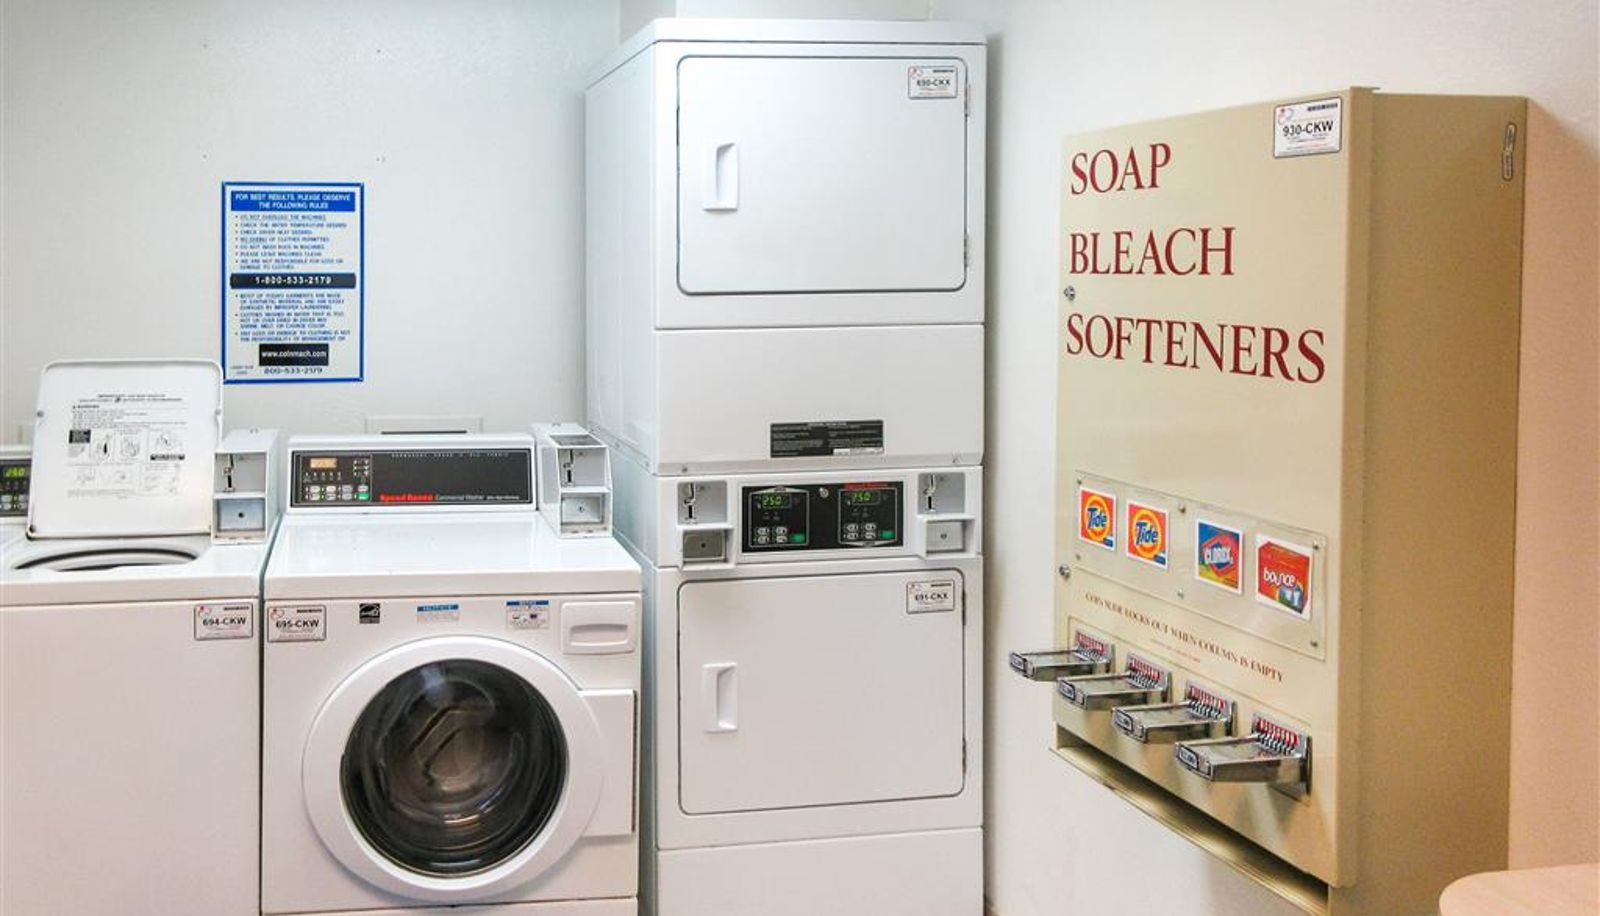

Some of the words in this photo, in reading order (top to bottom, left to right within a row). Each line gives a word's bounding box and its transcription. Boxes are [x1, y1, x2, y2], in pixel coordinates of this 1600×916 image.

[1282, 120, 1334, 136] 930-CKW
[1071, 142, 1171, 196] SOAP
[1070, 227, 1235, 276] BLEACH
[255, 276, 332, 285] 1-800-533-2179
[261, 350, 327, 358] www.coinmach.com
[1066, 313, 1325, 384] SOFTENERS
[1087, 507, 1108, 530] Tide
[1136, 522, 1158, 546] Tide
[202, 617, 246, 626] 694-CKW
[276, 619, 320, 628] 695-CKW
[1124, 608, 1150, 624] LOCKS
[1151, 621, 1168, 634] OUT
[1171, 627, 1196, 646] WHEN
[1198, 640, 1238, 662] COLUMN
[1240, 656, 1249, 668] IS
[1250, 660, 1283, 682] EMPTY
